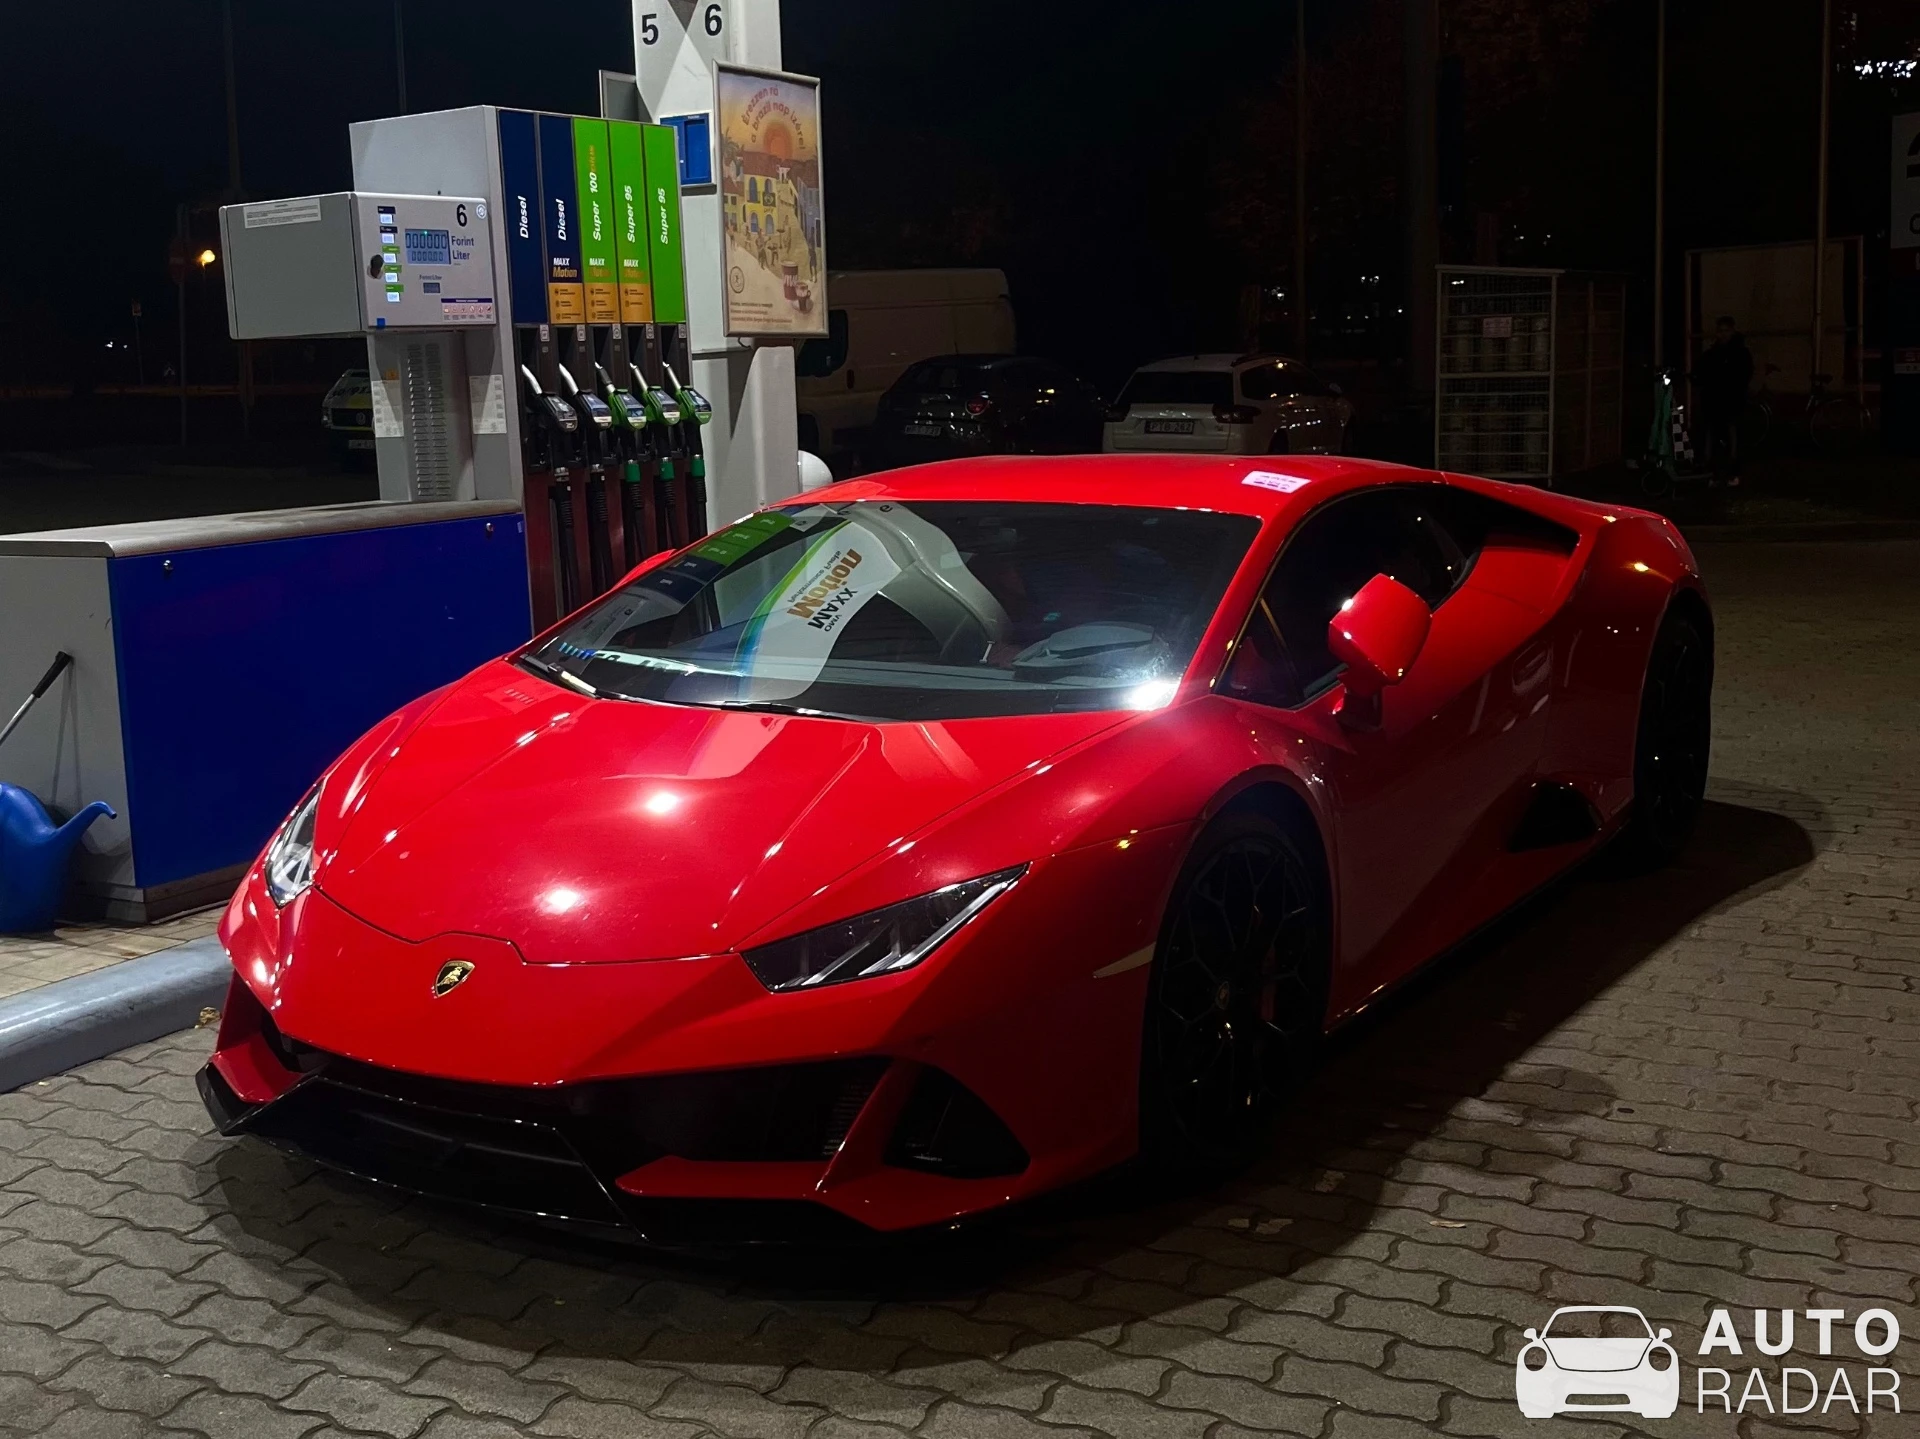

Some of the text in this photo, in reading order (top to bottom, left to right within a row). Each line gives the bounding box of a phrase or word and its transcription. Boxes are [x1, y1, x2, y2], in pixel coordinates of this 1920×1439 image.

[641, 13, 659, 45] 5
[704, 4, 723, 36] 6
[752, 100, 772, 131] brazil
[772, 101, 790, 116] nap
[589, 172, 599, 194] 100
[456, 203, 468, 227] 6
[517, 195, 529, 239] Diesel
[555, 198, 567, 241] Diesel
[592, 201, 602, 242] Super
[624, 185, 636, 243] Super 95
[657, 187, 669, 245] Super 95
[451, 236, 475, 247] Forint
[452, 250, 470, 260] Liter
[552, 266, 578, 279] Motion
[553, 257, 570, 266] MAXX
[589, 257, 605, 266] MAXX
[623, 259, 639, 267] MAXX
